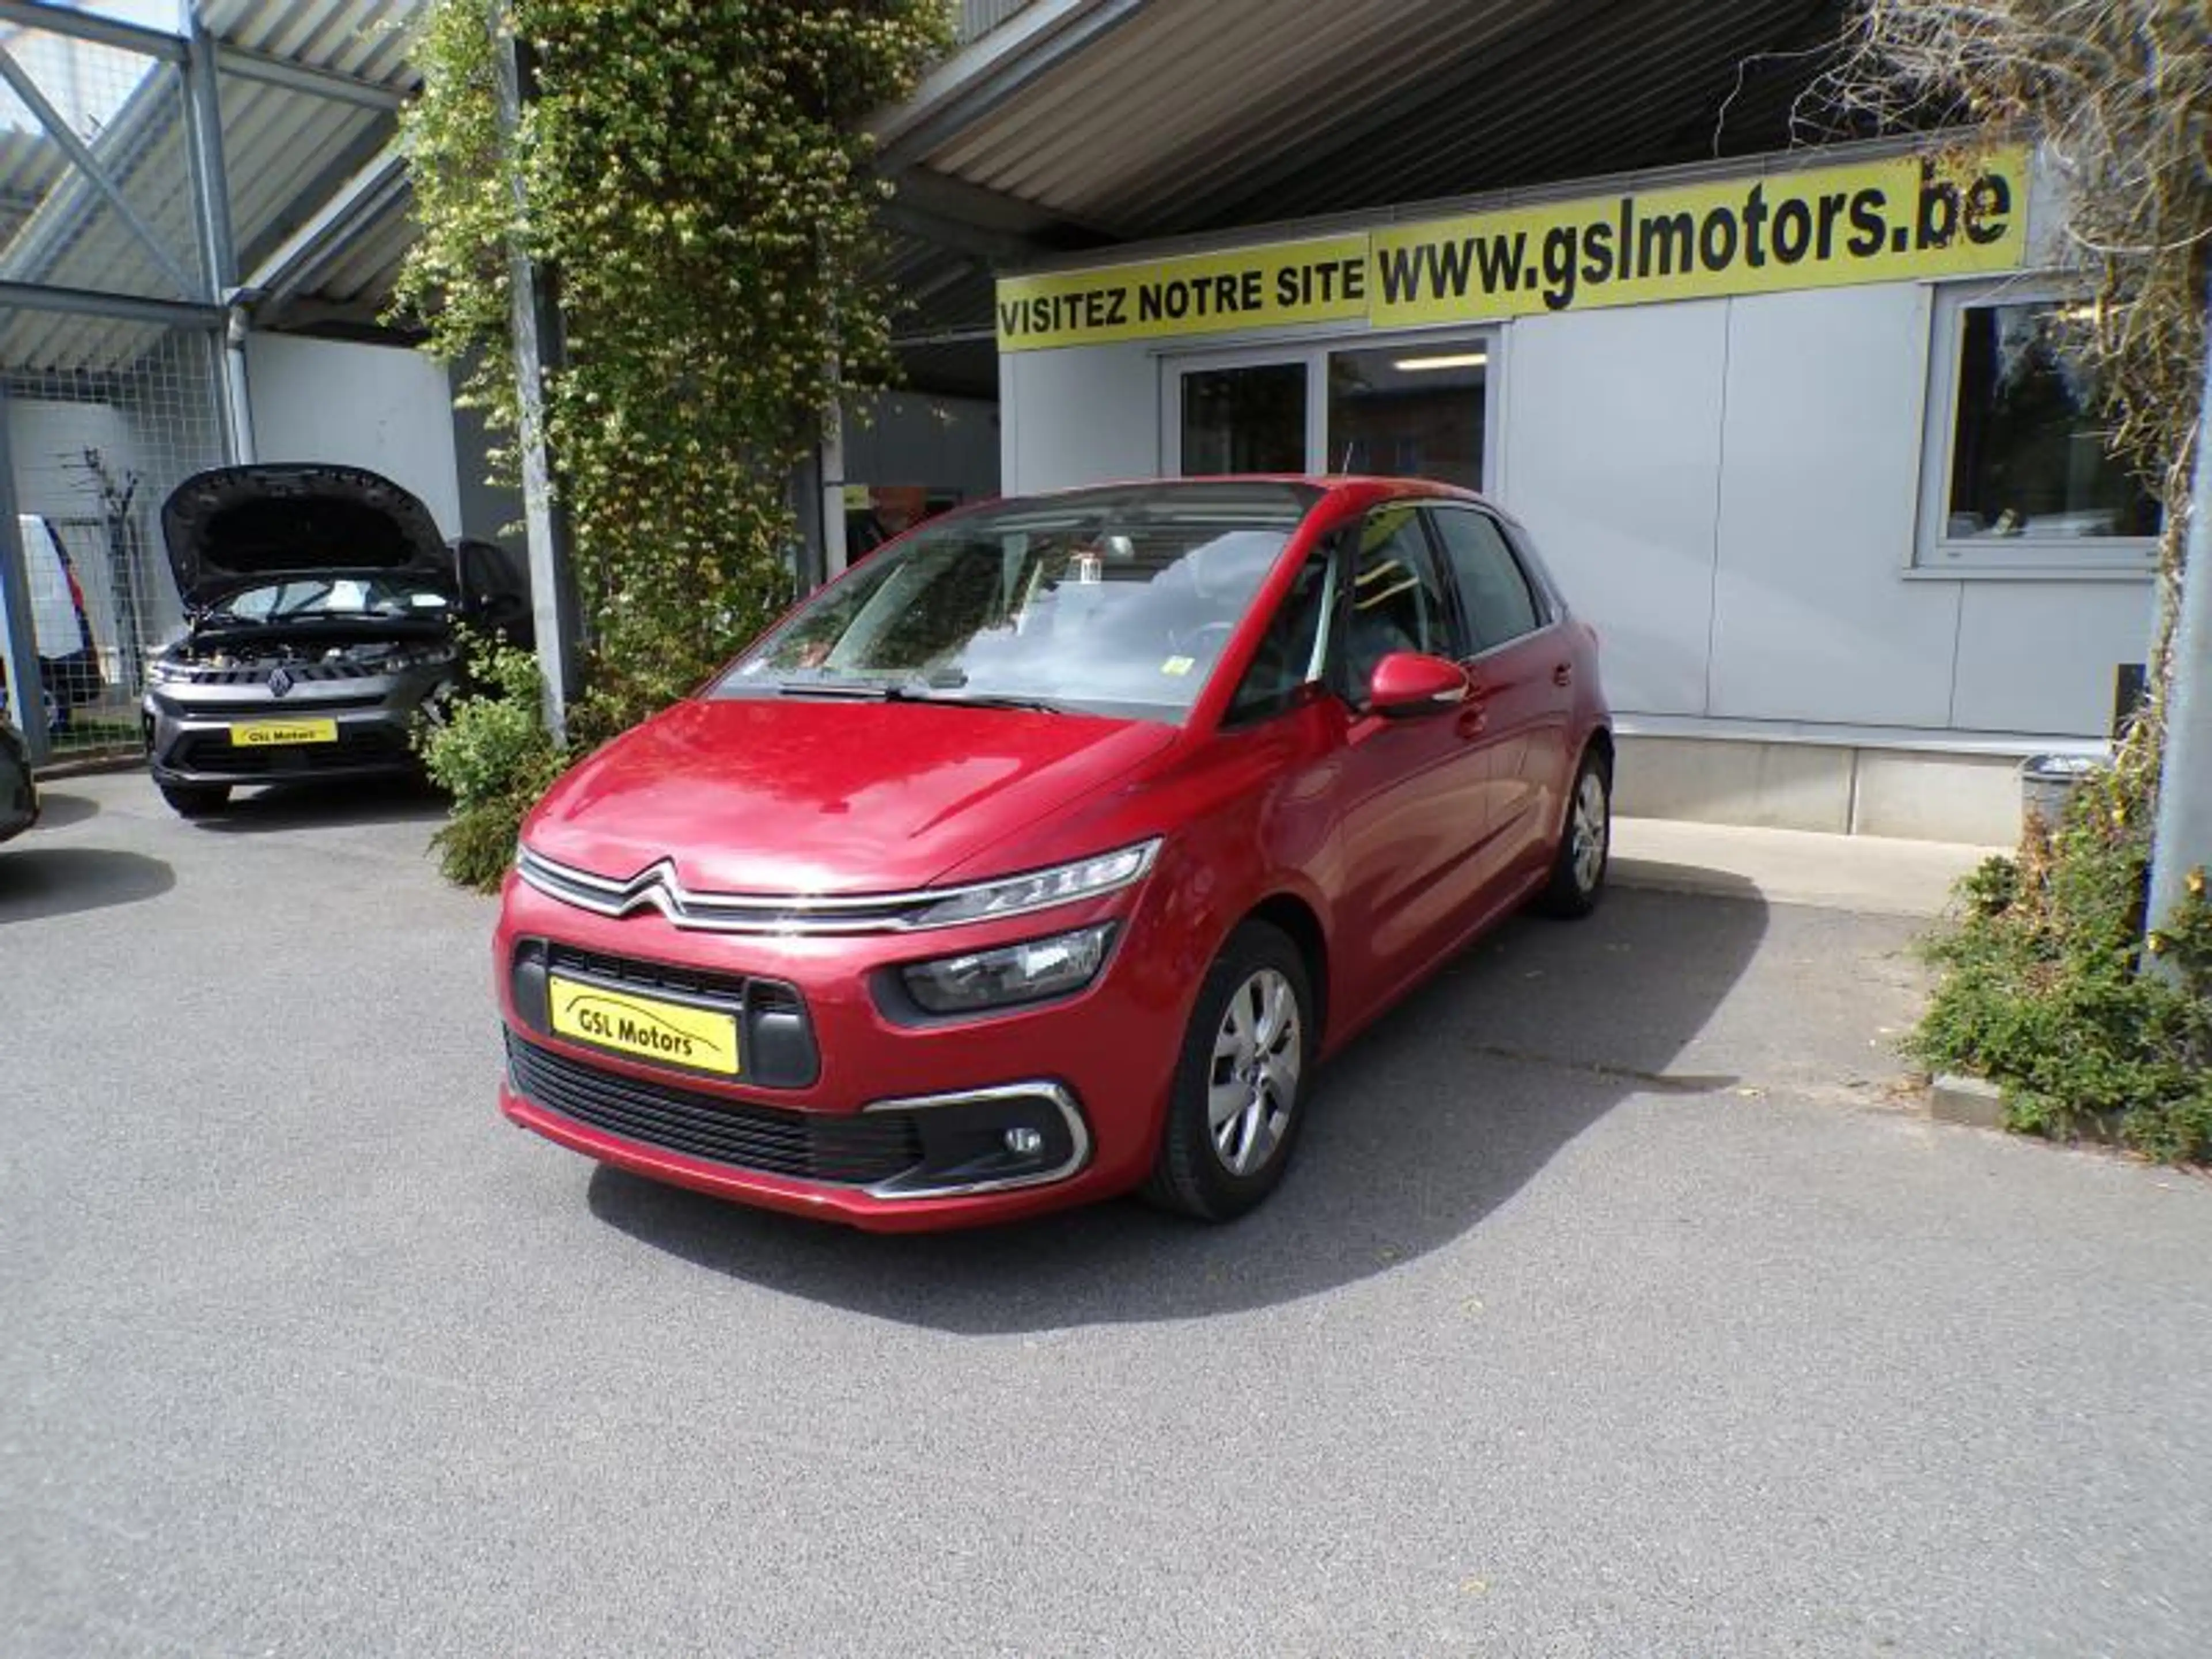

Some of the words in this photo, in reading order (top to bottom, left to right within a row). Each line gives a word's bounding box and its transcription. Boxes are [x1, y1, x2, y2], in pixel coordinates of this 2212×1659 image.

[1000, 288, 1127, 336] VISITEZ
[1139, 271, 1262, 321] NOTRE
[1277, 259, 1364, 306] SITE
[1378, 157, 2011, 310] www.gslmotors.be
[579, 1009, 612, 1037] GSL
[619, 1018, 693, 1055] Motors
